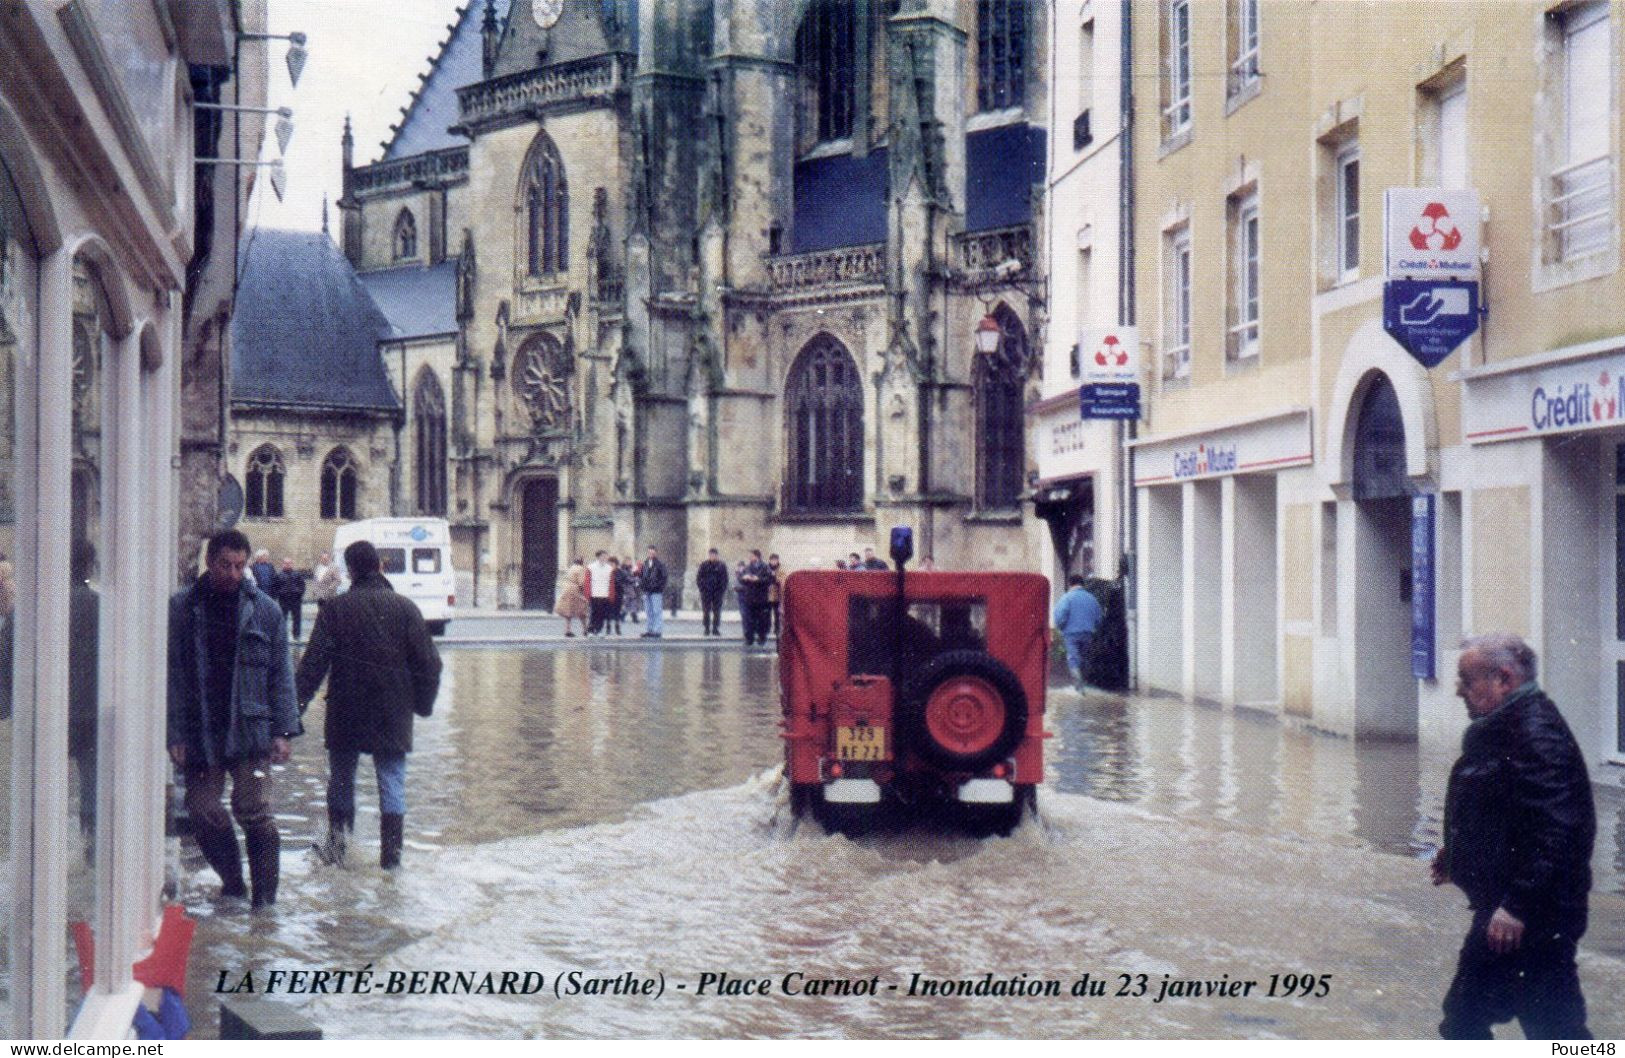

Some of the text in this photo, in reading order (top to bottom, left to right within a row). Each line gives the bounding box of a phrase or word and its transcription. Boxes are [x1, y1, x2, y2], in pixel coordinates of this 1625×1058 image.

[1532, 386, 1591, 430] Crédit
[1174, 443, 1237, 478] Crédit Mutuel
[847, 727, 875, 741] 329
